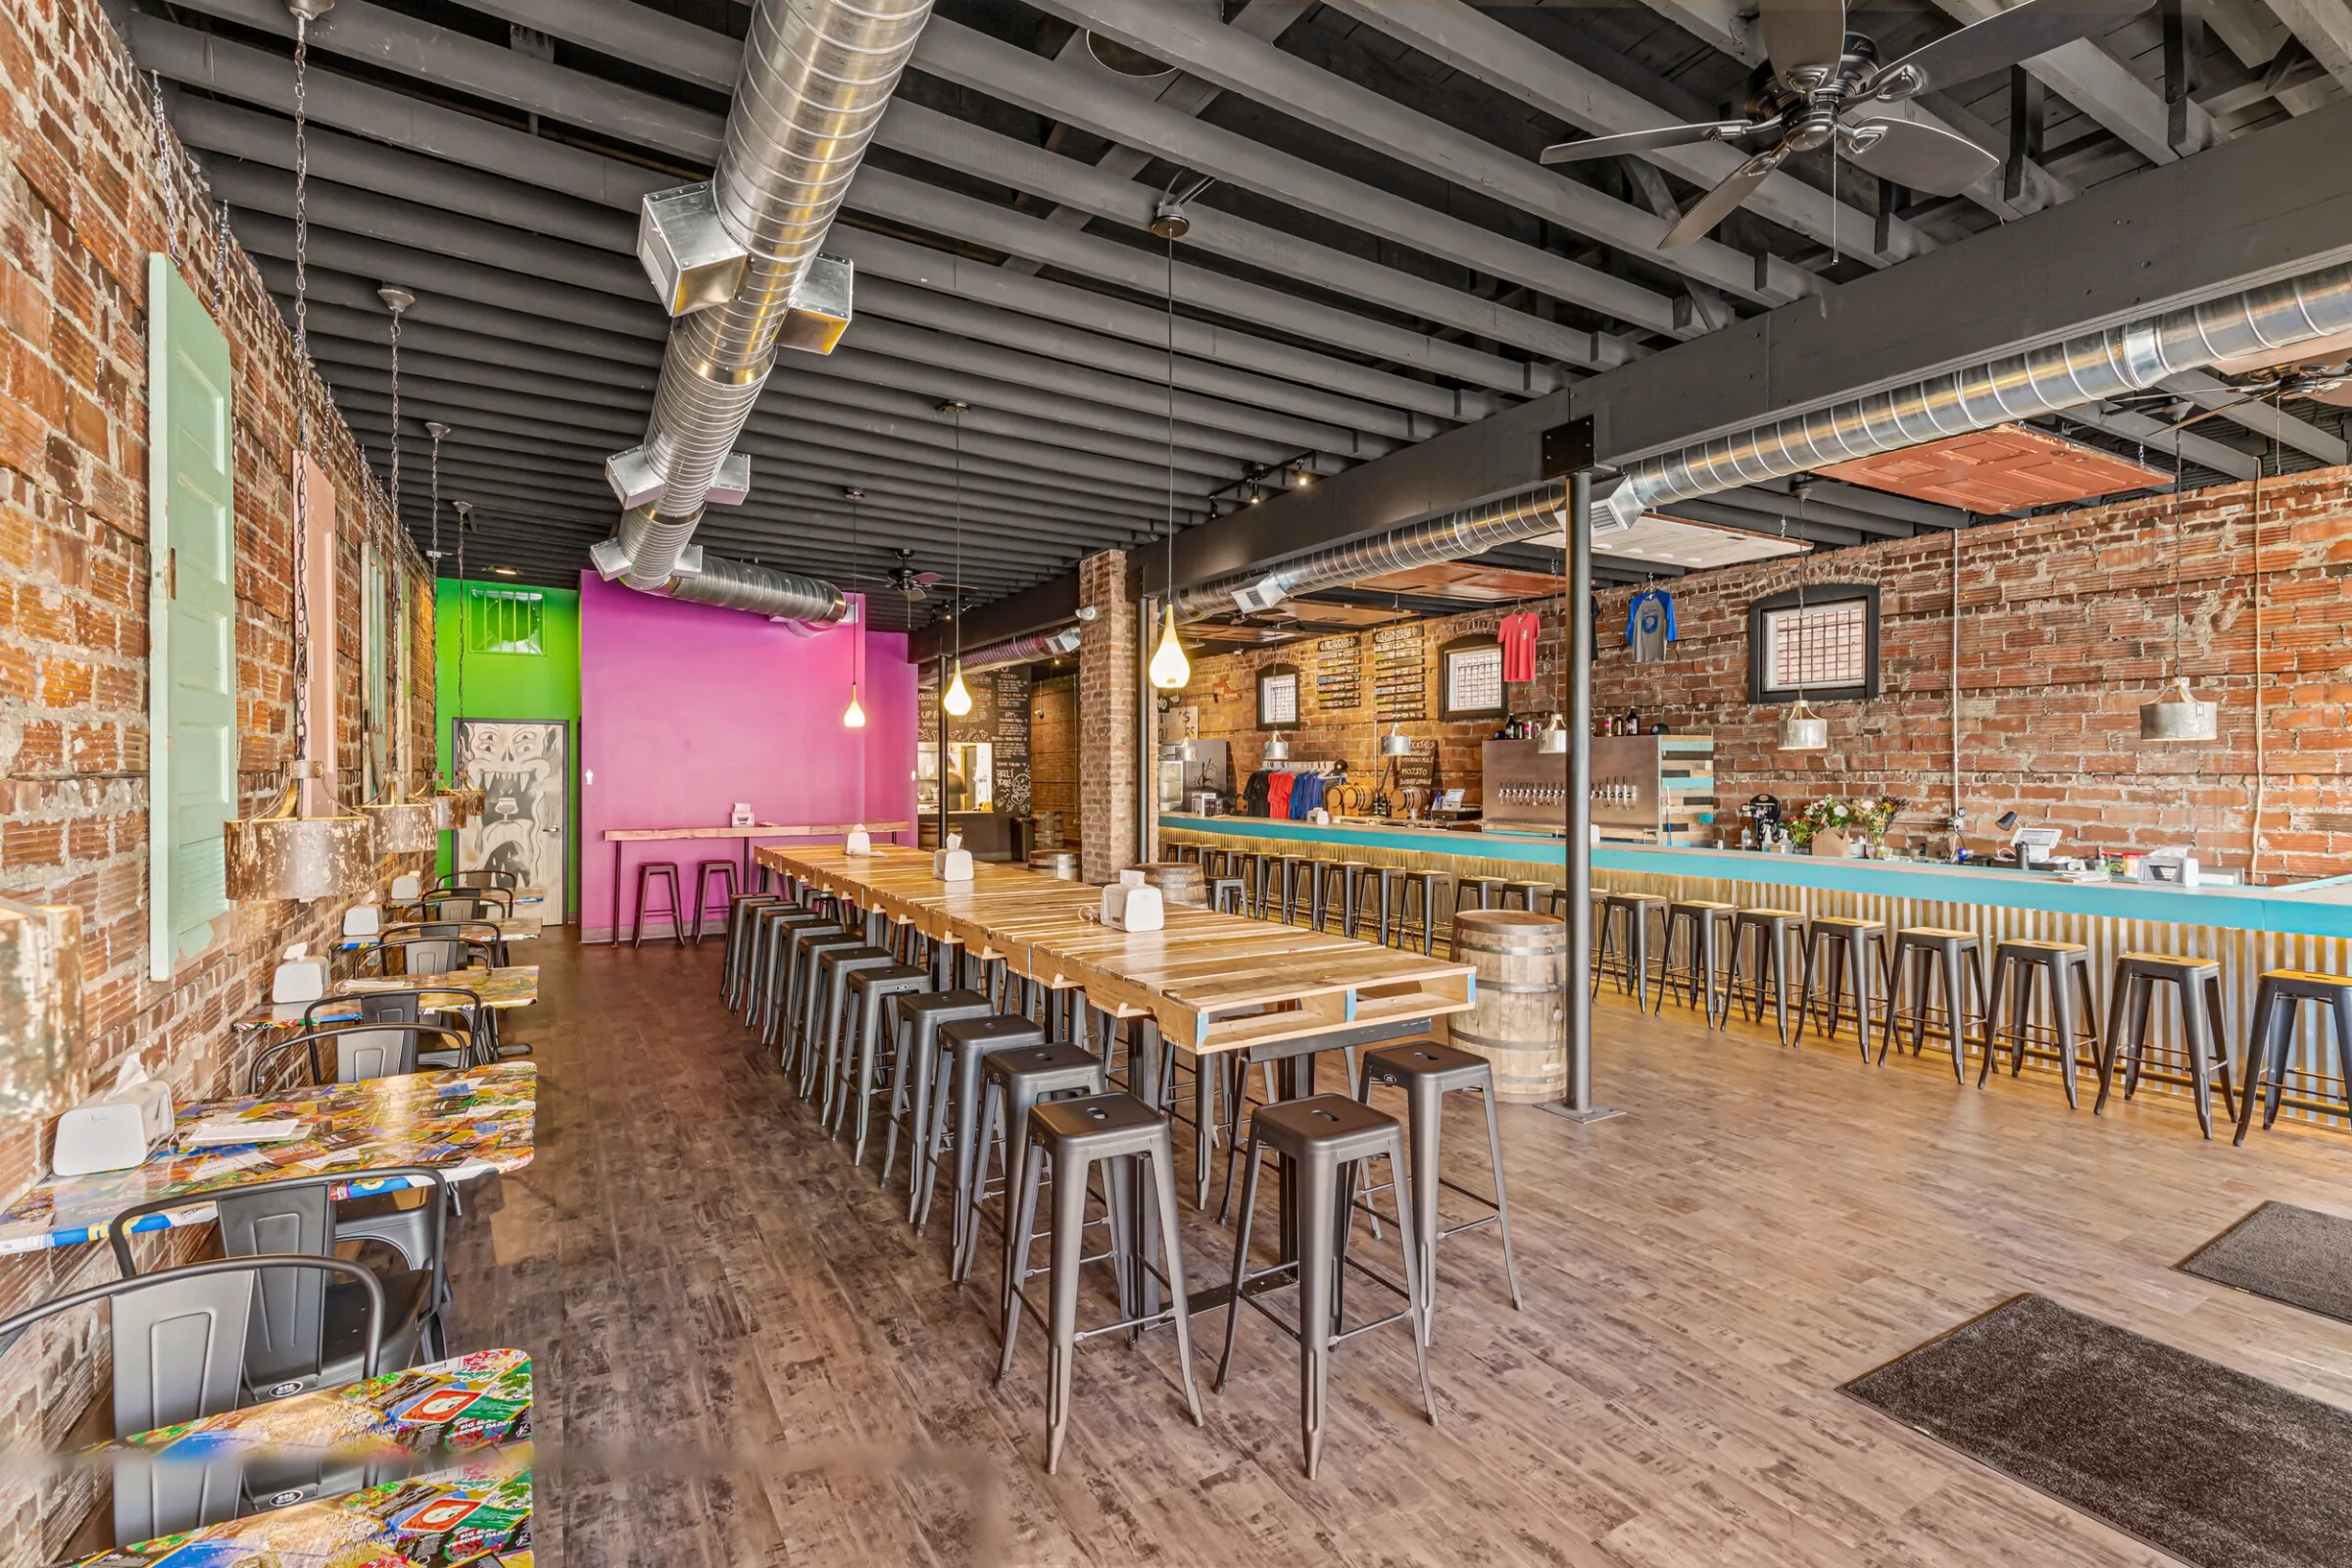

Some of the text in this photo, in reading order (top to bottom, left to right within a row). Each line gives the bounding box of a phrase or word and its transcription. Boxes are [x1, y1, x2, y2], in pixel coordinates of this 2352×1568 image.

[1401, 767, 1428, 776] MOJITO
[485, 1419, 517, 1430] DADDY
[485, 1529, 516, 1538] DADDY
